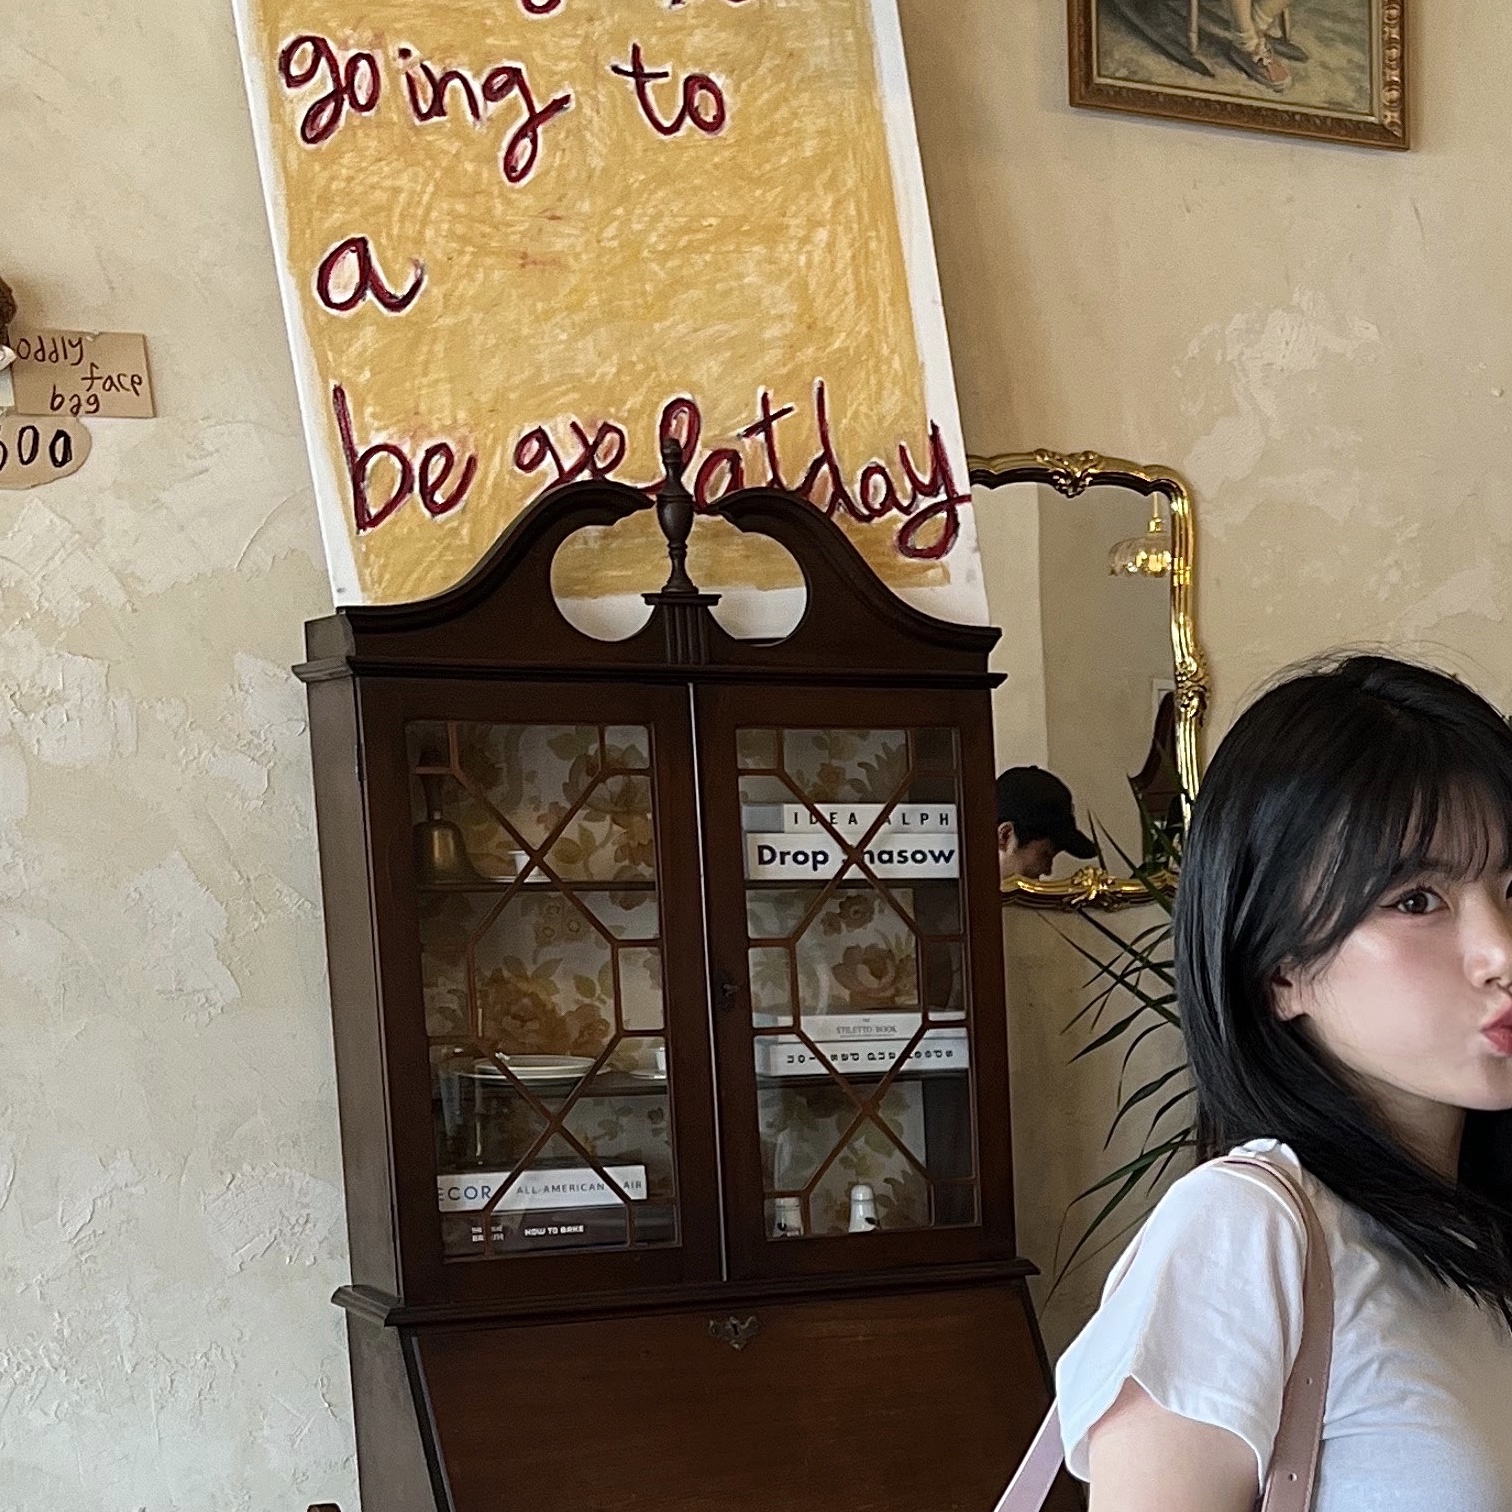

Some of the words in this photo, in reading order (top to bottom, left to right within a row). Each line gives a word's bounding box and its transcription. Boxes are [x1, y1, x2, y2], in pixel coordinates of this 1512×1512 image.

[278, 34, 573, 184] going
[610, 42, 727, 136] to
[318, 235, 427, 313] a
[16, 335, 84, 366] oddly
[80, 362, 143, 397] face
[50, 385, 100, 417] bag
[333, 383, 478, 532] be
[793, 811, 859, 826] IDEA
[756, 844, 830, 872] Drop
[523, 1227, 546, 1237] HOW
[547, 1226, 559, 1236] TO
[560, 1224, 585, 1235] BAKE
